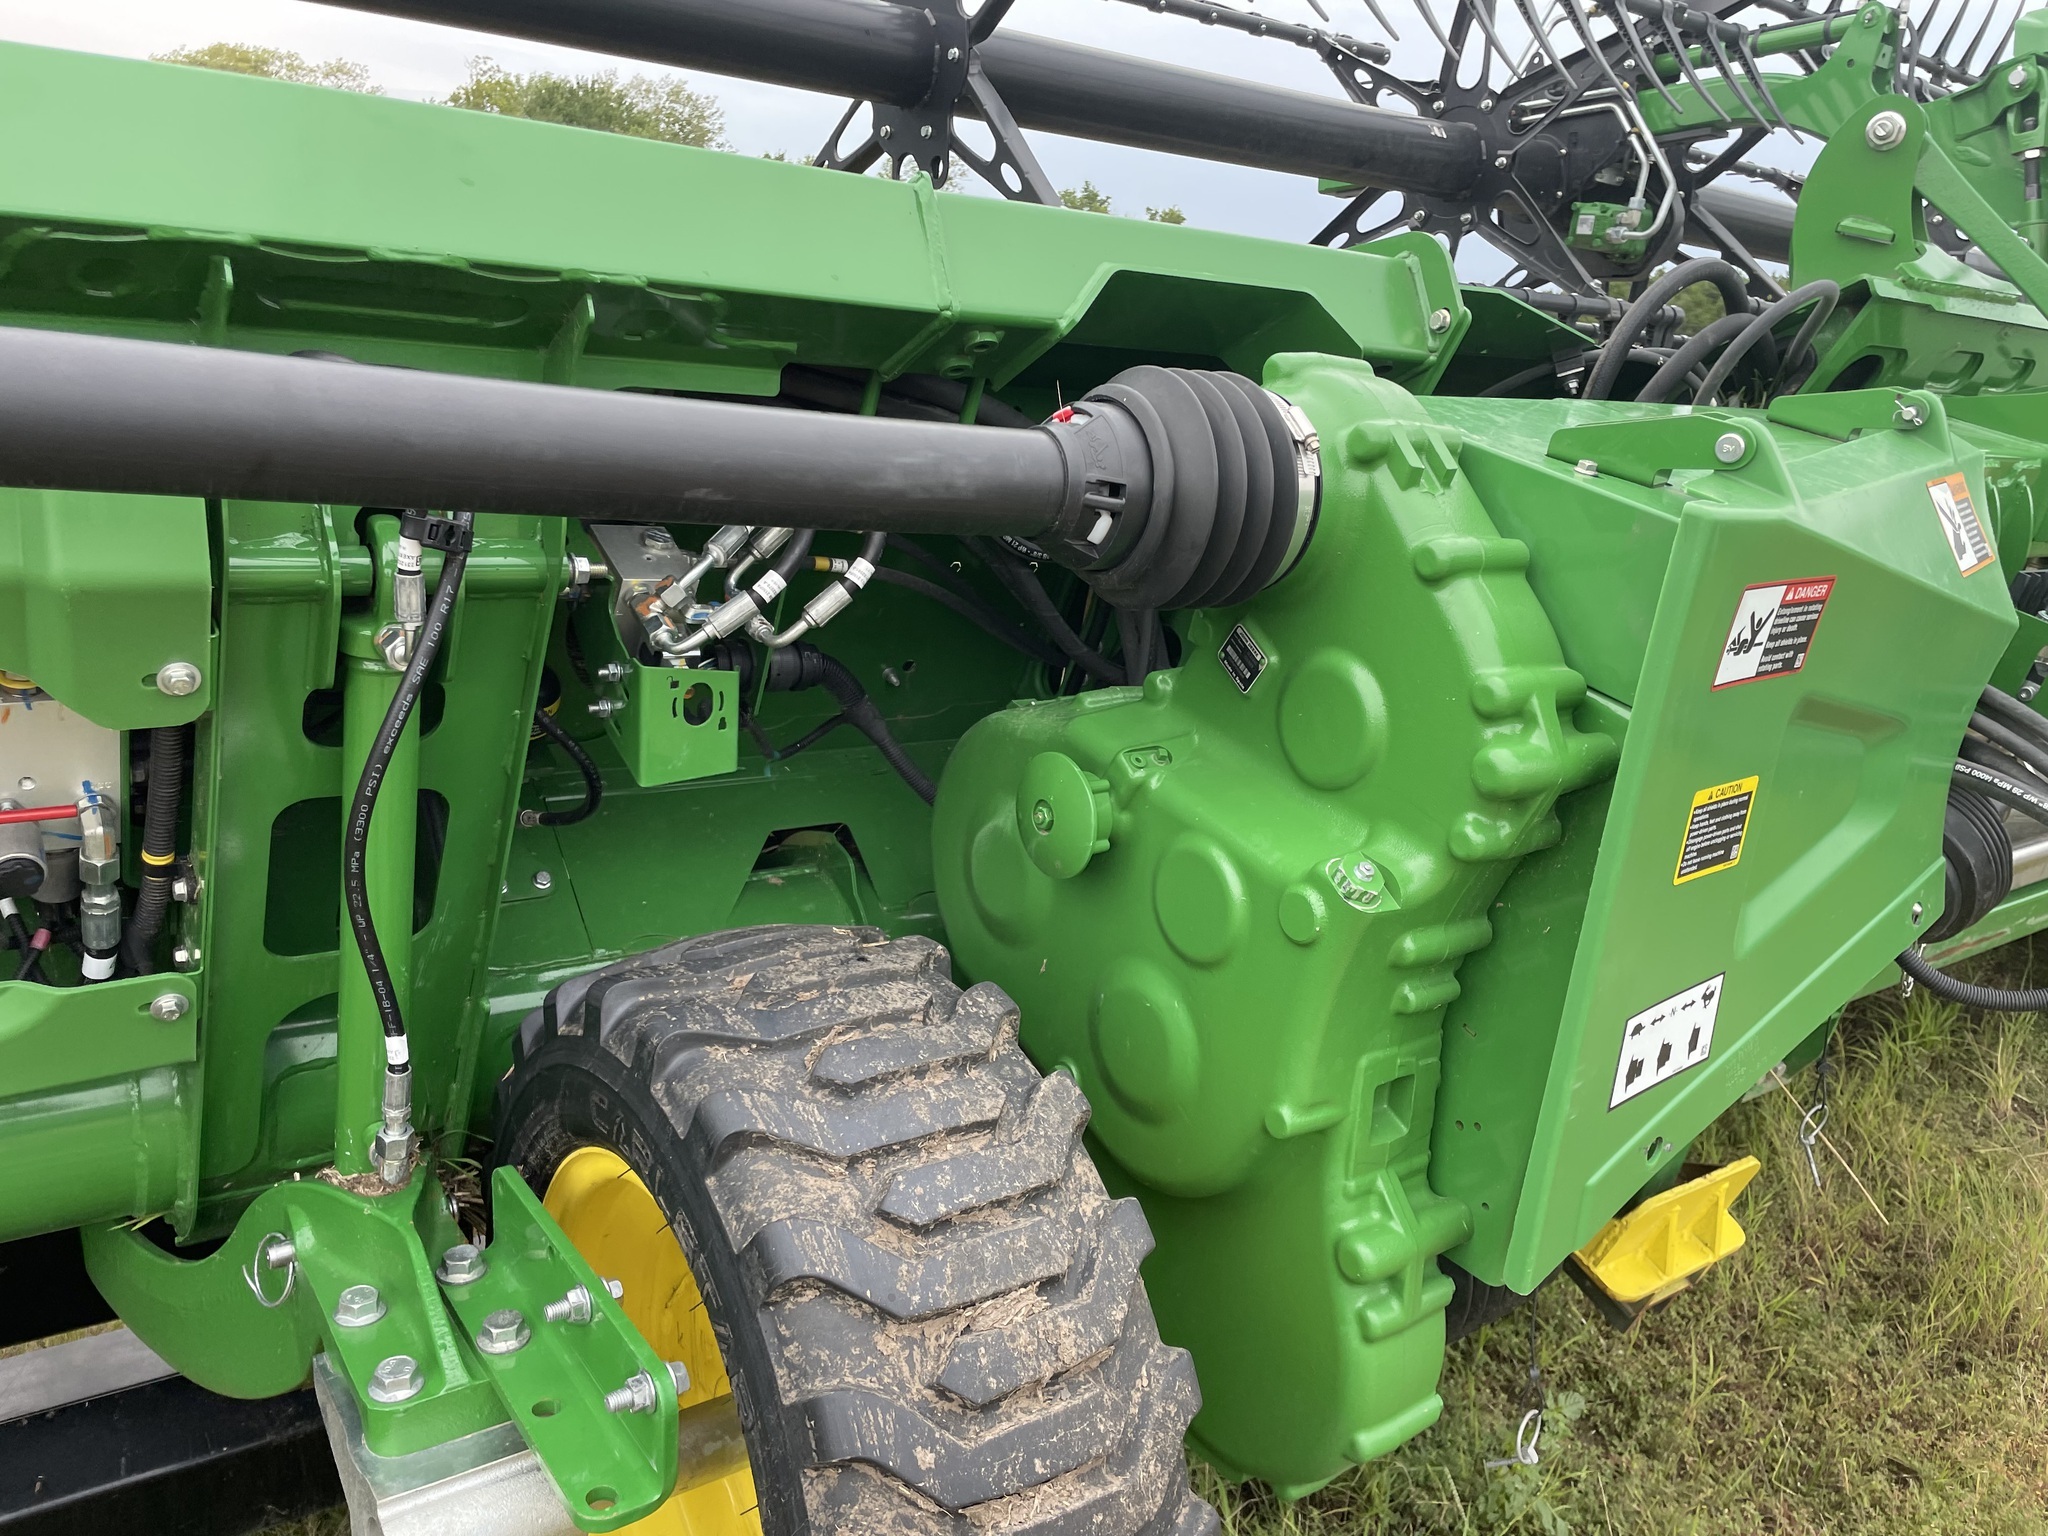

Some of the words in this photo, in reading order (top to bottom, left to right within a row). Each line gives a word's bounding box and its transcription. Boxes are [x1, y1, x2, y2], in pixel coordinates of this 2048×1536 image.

[440, 585, 455, 614] R17
[1794, 584, 1829, 600] DANGER
[427, 622, 443, 647] 100
[412, 656, 429, 685] SAE
[383, 693, 414, 754] exceeds
[365, 764, 383, 797] PSI)
[1716, 782, 1743, 798] CAUTION
[1993, 778, 2013, 791] MPa
[2011, 787, 2024, 796] 28
[2022, 793, 2039, 805] WP
[353, 804, 369, 842] (3300
[350, 851, 361, 873] MPa
[351, 879, 362, 907] 22.5
[355, 914, 367, 928] WP
